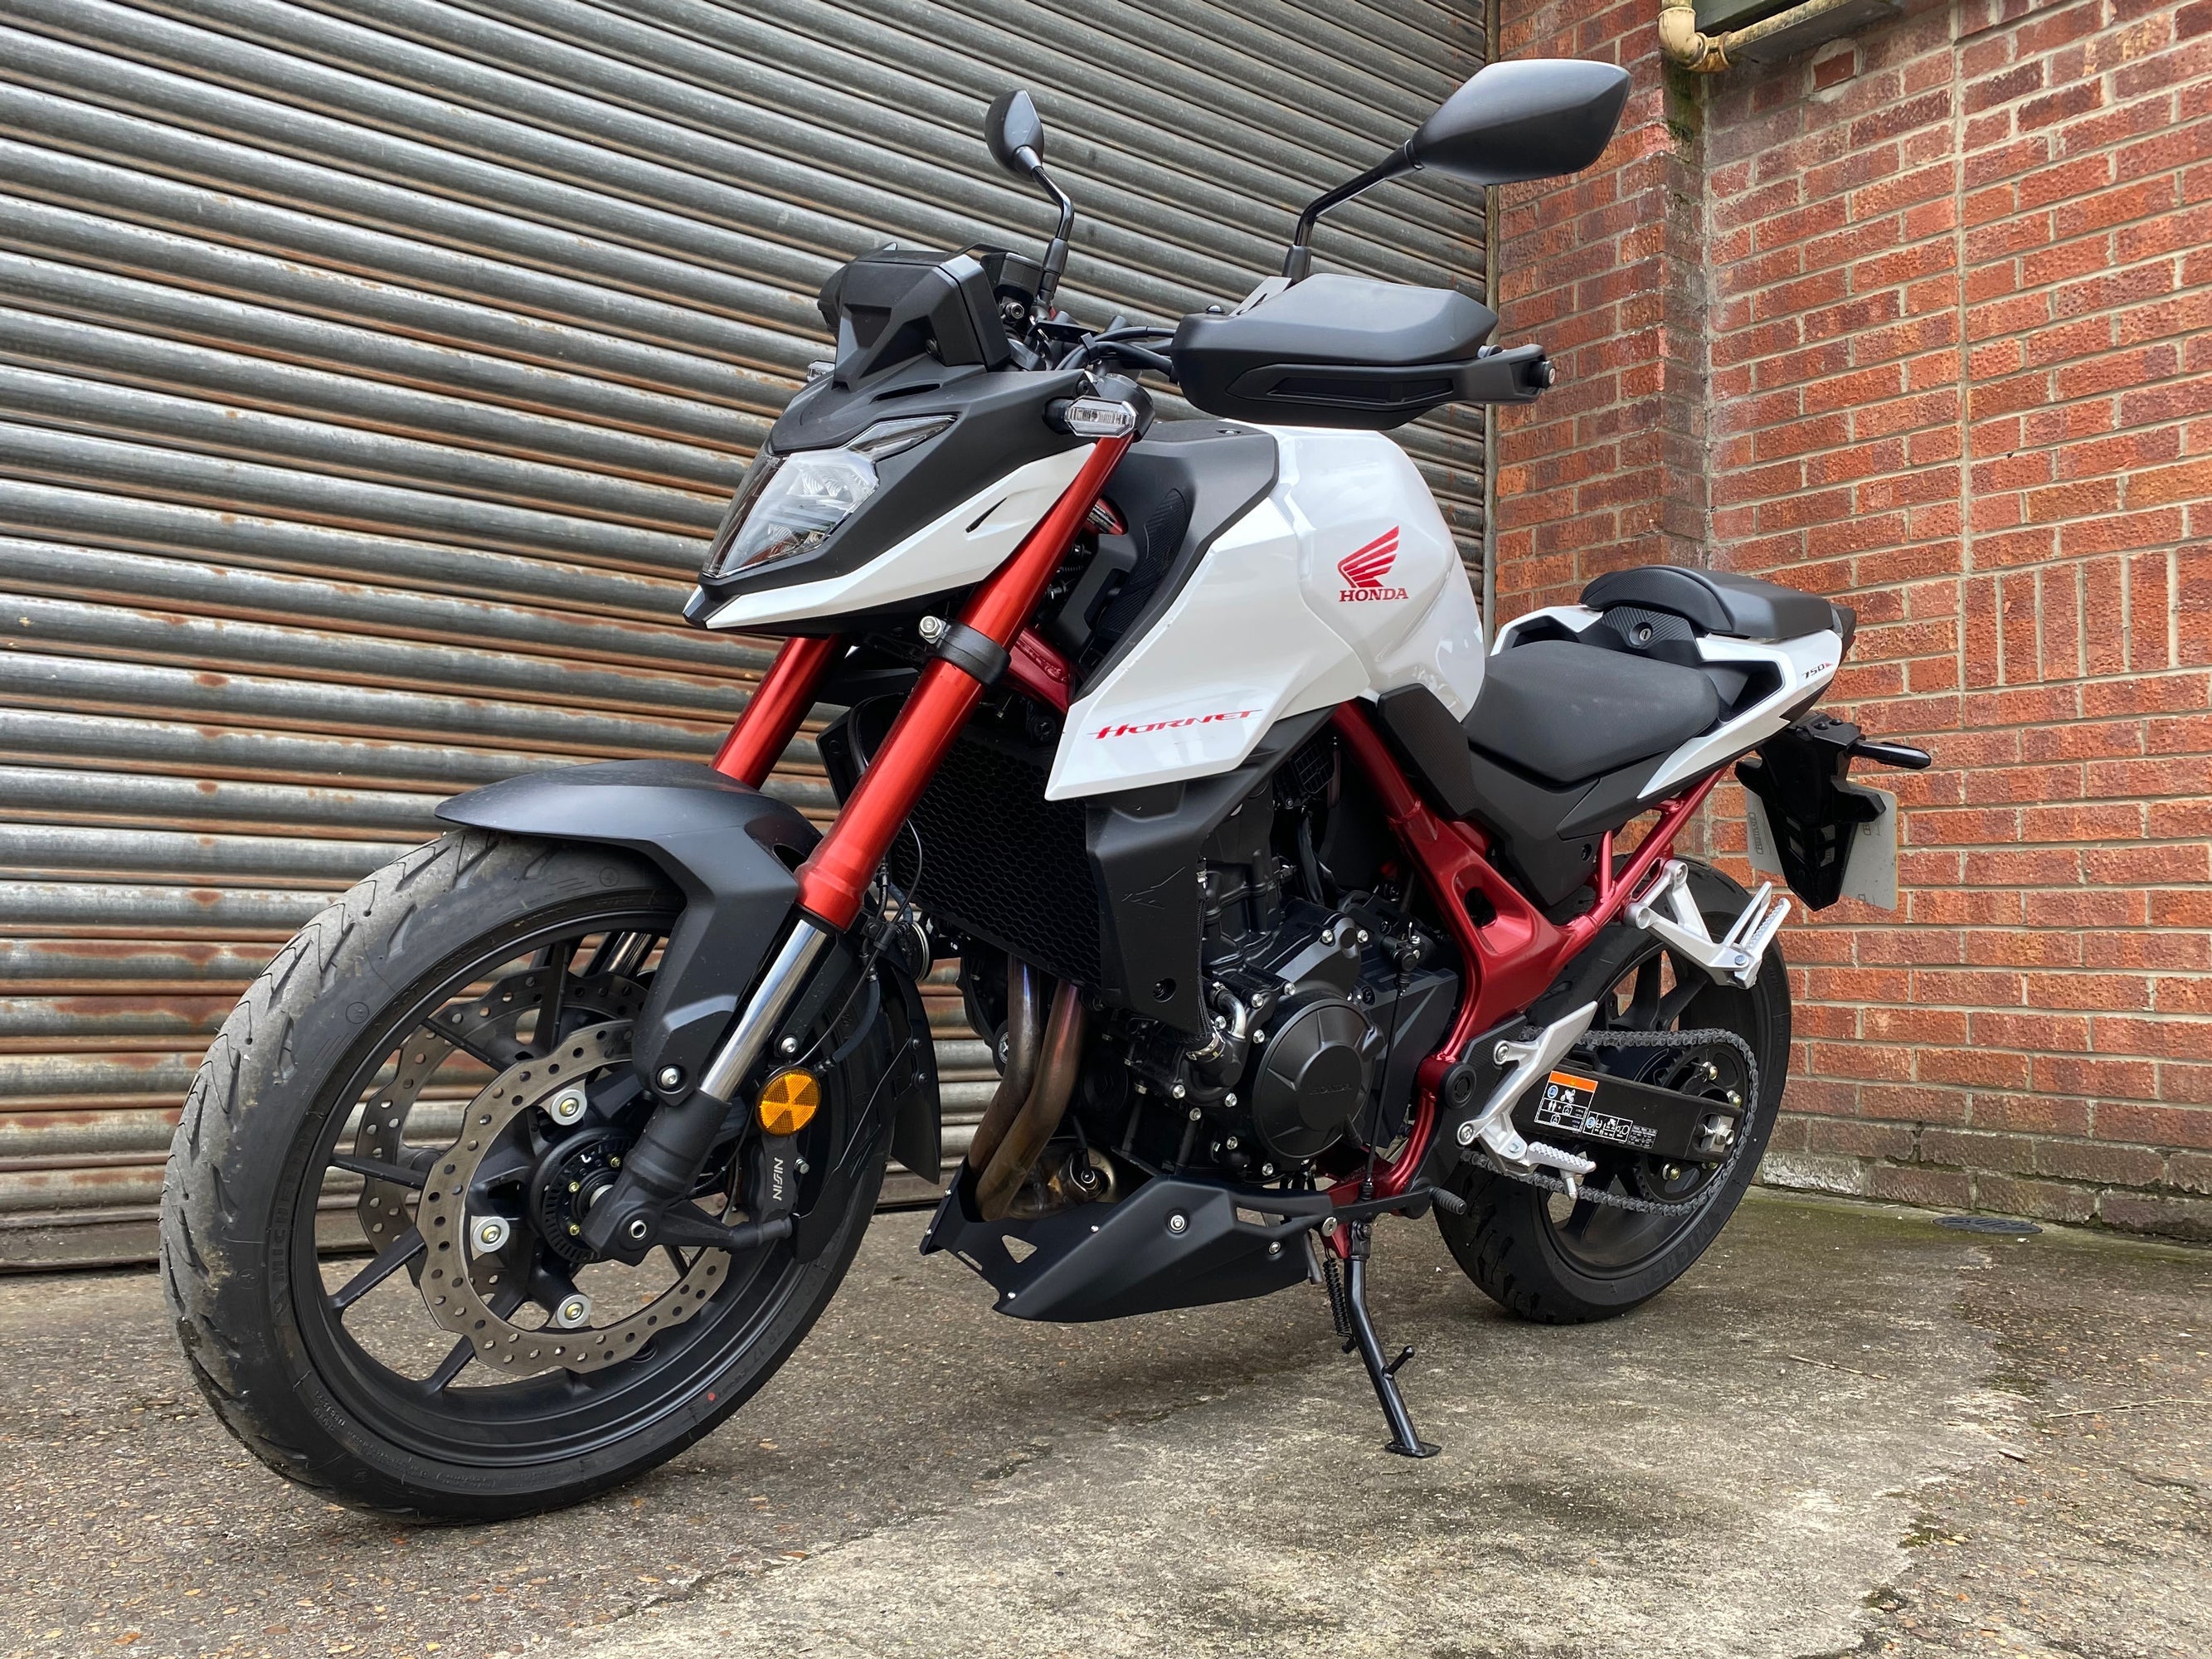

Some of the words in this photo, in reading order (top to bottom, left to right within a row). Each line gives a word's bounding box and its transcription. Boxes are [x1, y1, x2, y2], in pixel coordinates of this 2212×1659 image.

[1339, 587, 1409, 602] HONDA
[1801, 664, 1826, 679] 750
[1087, 708, 1263, 740] HORNET
